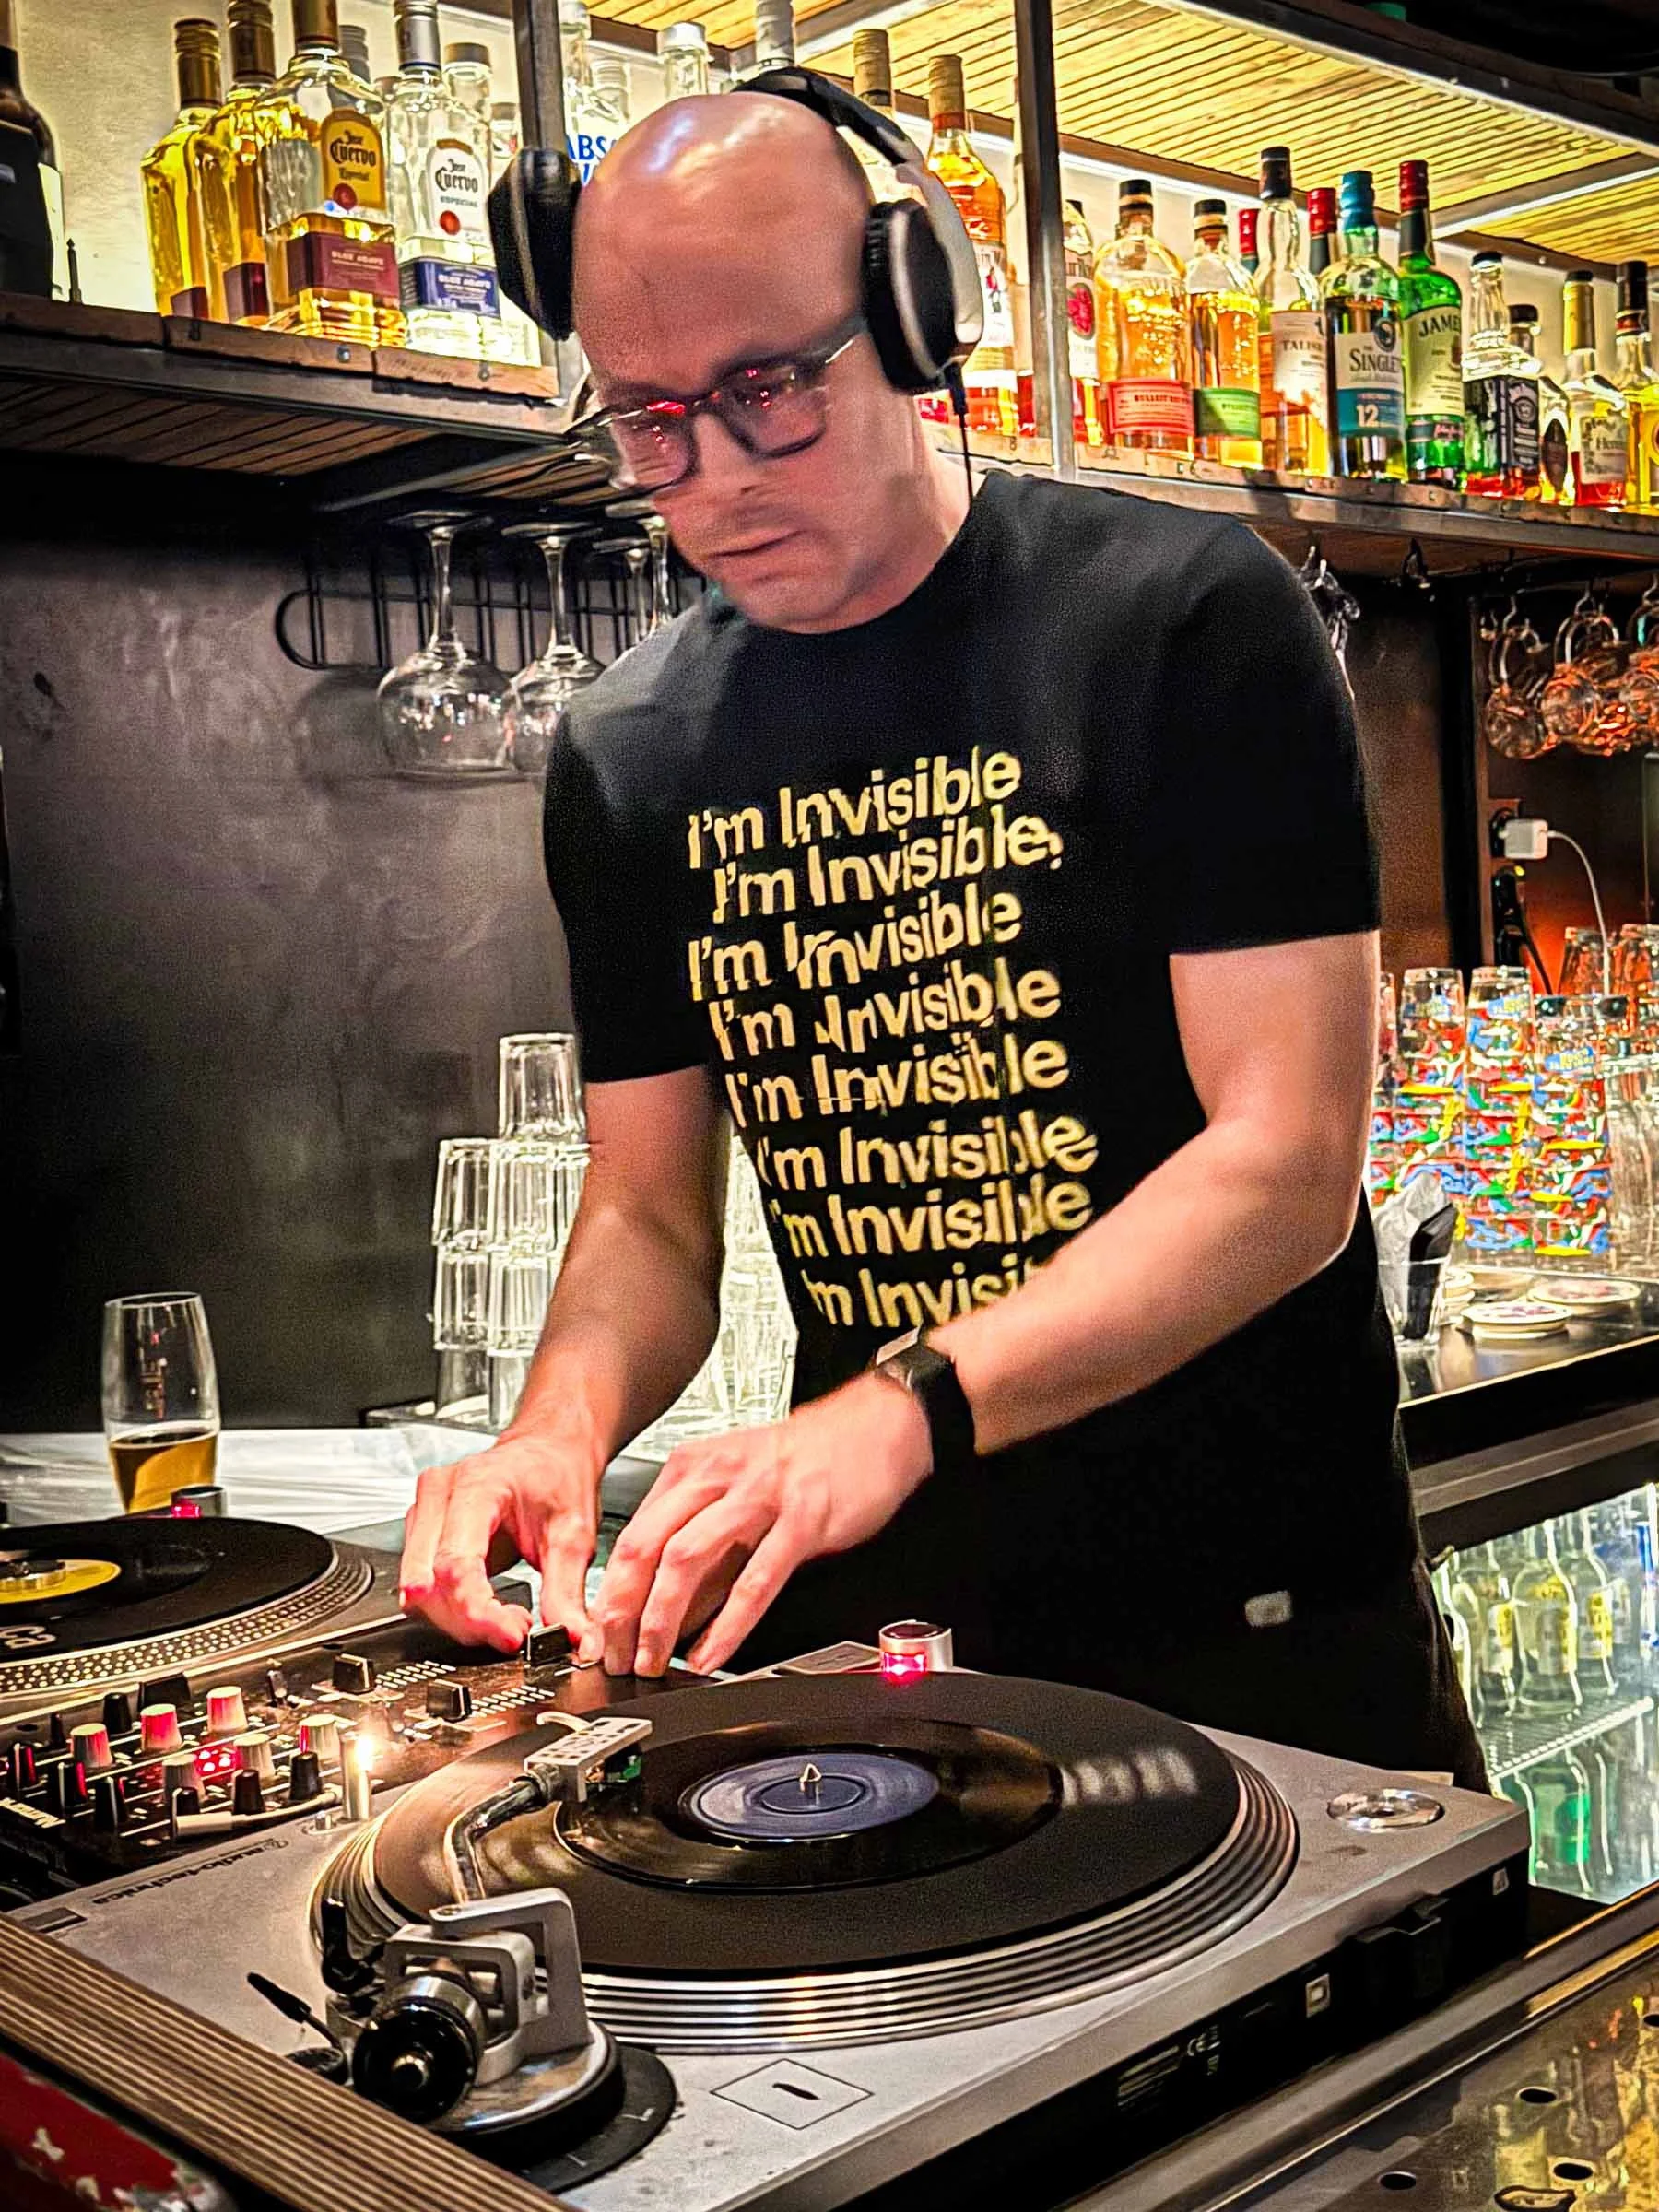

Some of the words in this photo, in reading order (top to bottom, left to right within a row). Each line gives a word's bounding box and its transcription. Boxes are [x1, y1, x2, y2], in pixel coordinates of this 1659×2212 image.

[330, 138, 377, 167] Cuervo
[435, 166, 478, 193] Cuervo
[565, 134, 610, 160] BS
[1357, 404, 1380, 428] 12
[688, 806, 764, 869] I'm
[780, 746, 1022, 848] Invisible
[712, 862, 796, 924] I'm
[688, 936, 772, 1001] I'm
[784, 882, 1023, 990] Invisible
[709, 999, 796, 1061] I'm
[815, 956, 1061, 1053] Invisible
[724, 1072, 804, 1128] I'm
[811, 1031, 1070, 1115] Invisible
[839, 1109, 1099, 1187] Invisible
[769, 1198, 829, 1259] 'm
[858, 1253, 1043, 1328] Invisi
